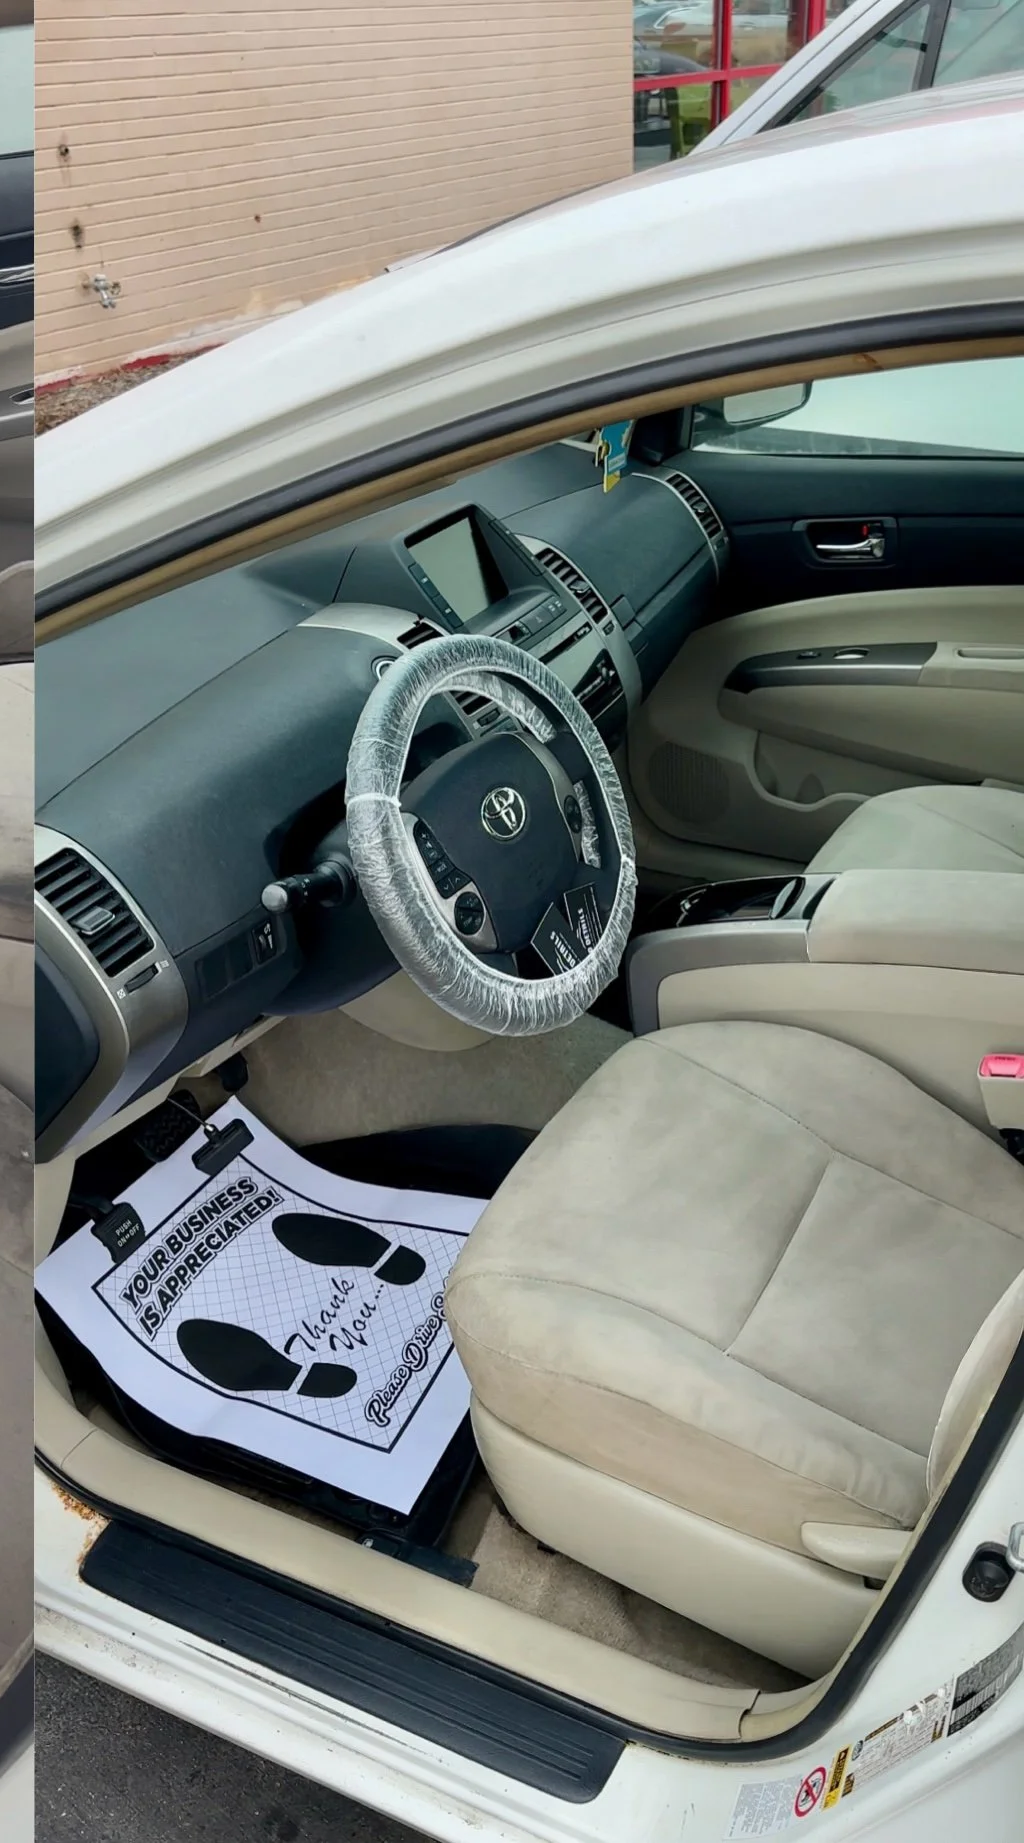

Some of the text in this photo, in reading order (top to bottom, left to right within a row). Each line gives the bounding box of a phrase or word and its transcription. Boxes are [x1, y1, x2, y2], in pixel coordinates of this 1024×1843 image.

[549, 930, 576, 968] DETAILS
[115, 1219, 133, 1237] PUSH
[121, 1178, 257, 1311] YOUR BUSINESS
[138, 1188, 282, 1339] IS APPRECIATED!
[283, 1276, 355, 1355] Thank
[366, 1314, 440, 1426] Please Drive
